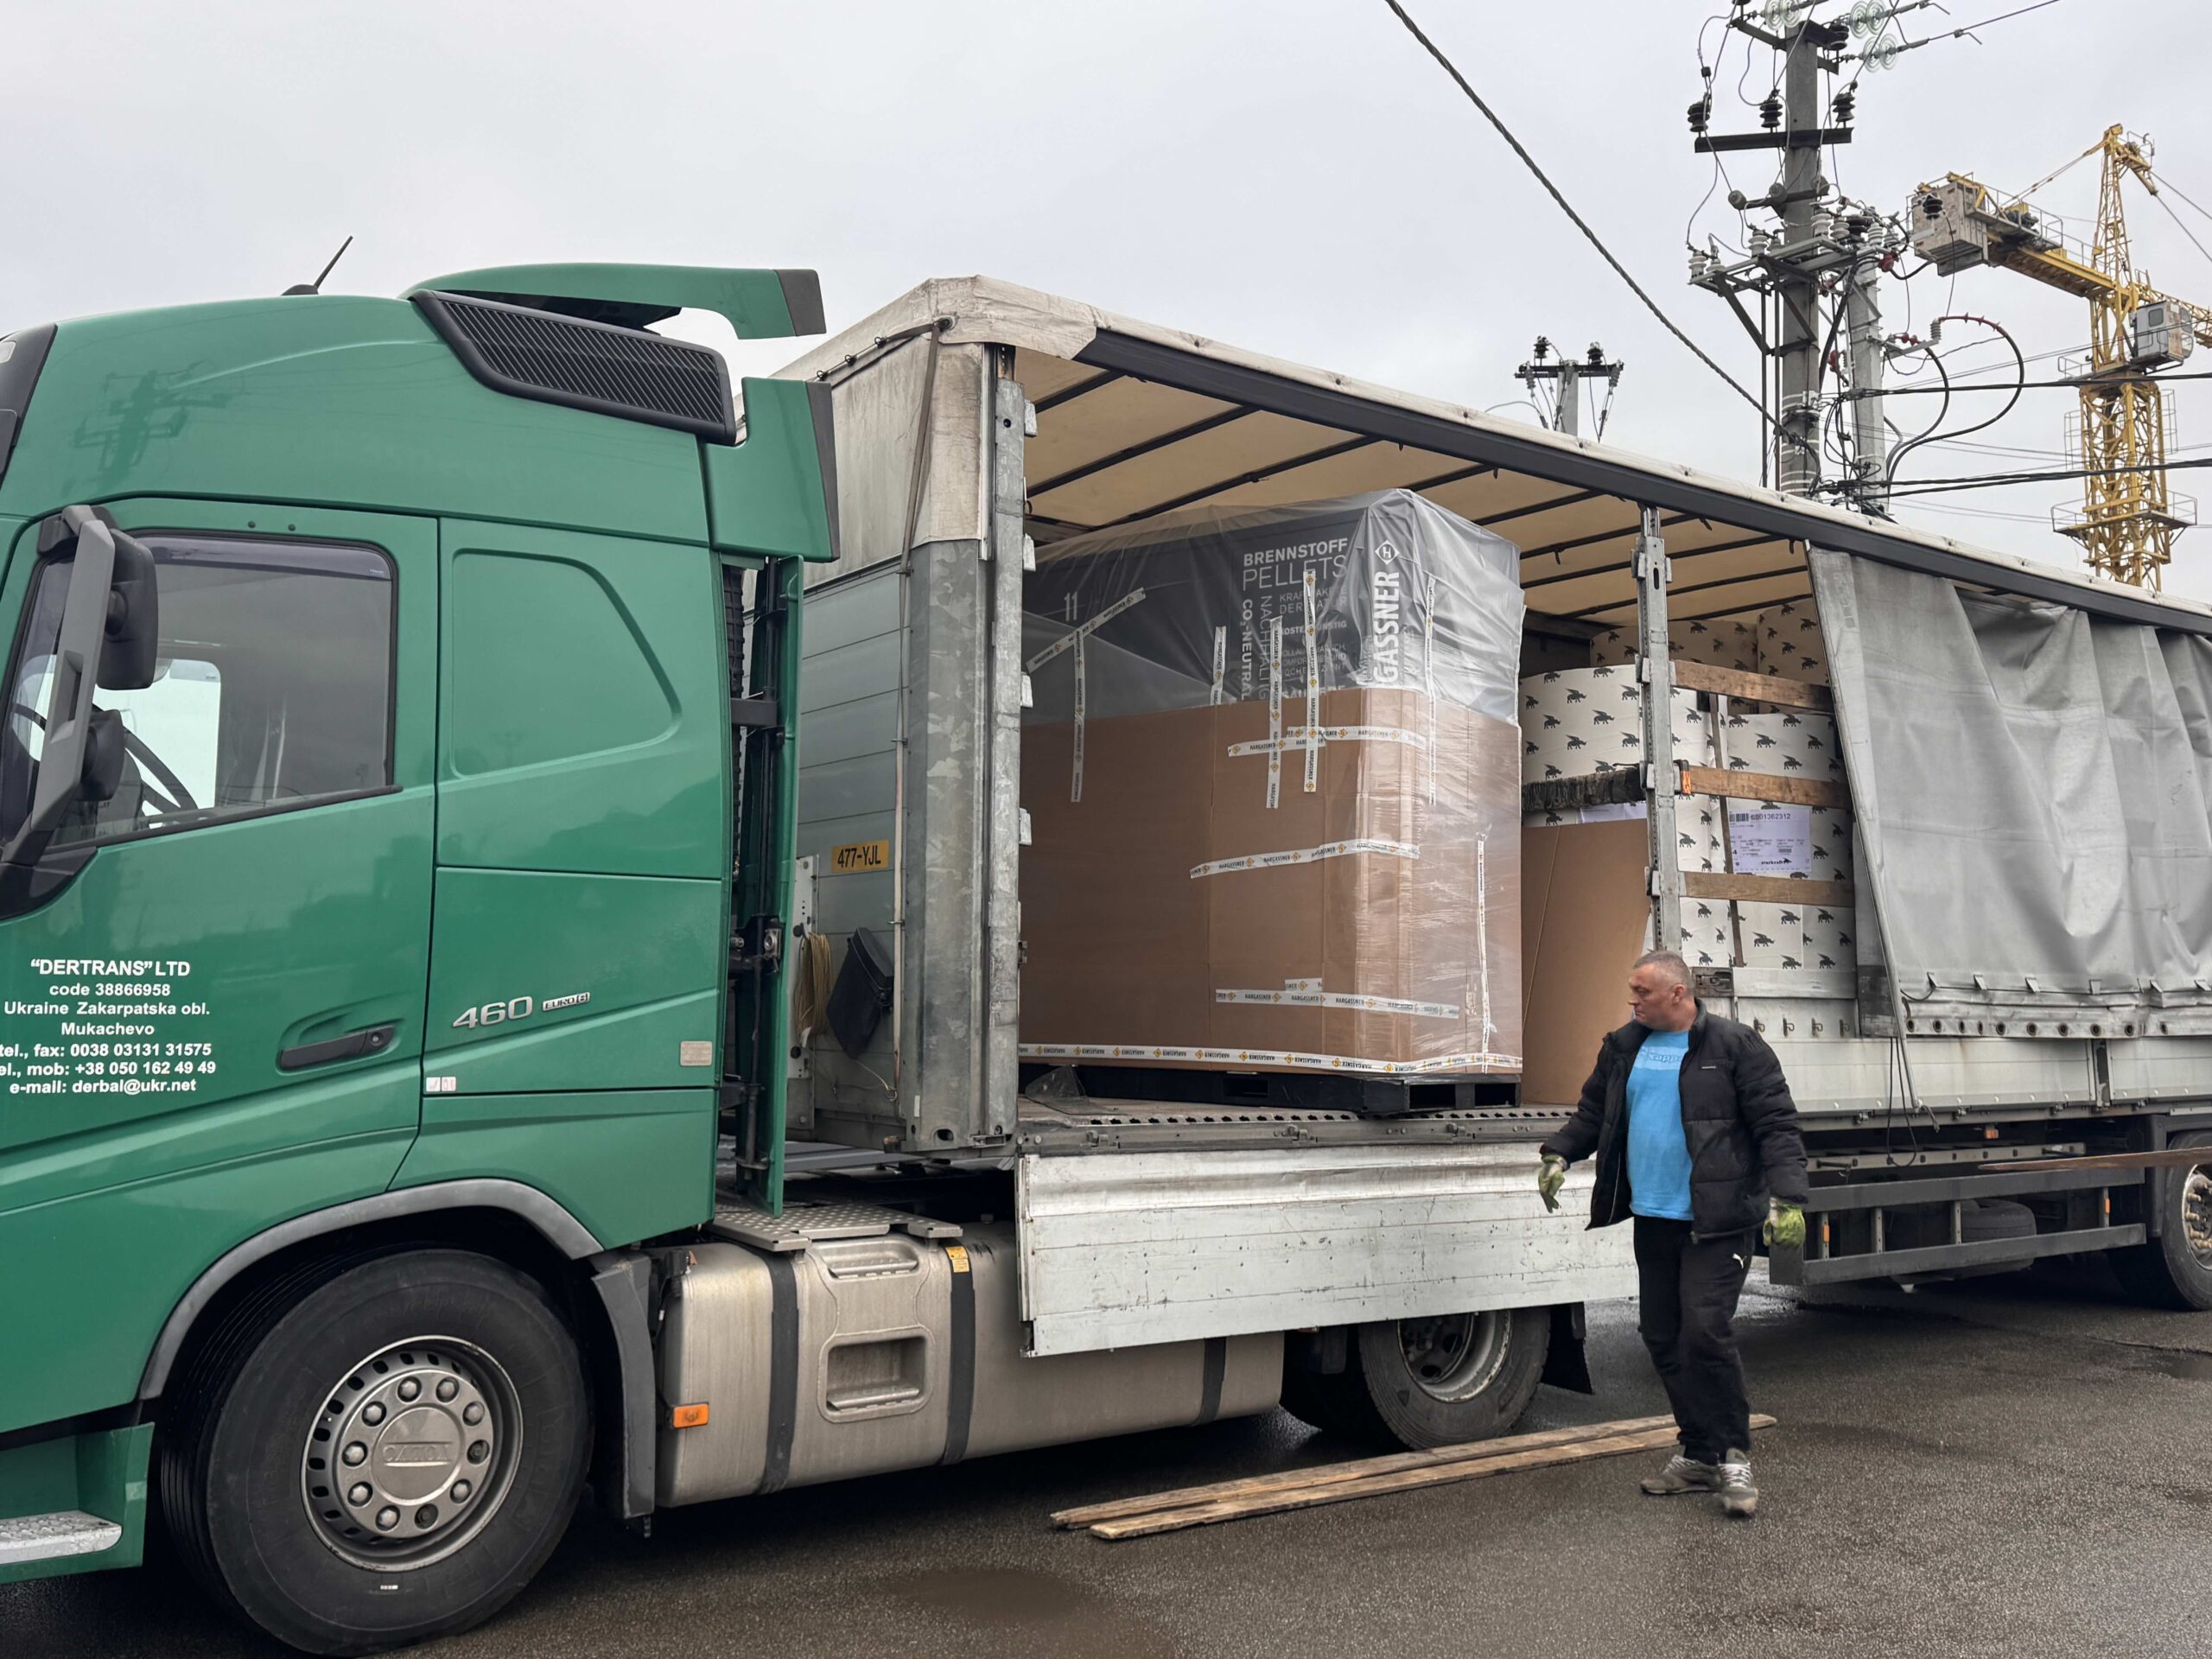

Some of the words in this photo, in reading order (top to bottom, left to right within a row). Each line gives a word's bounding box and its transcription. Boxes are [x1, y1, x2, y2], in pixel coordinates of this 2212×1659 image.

[1243, 538, 1348, 567] BRENNSTOFF
[1064, 591, 1078, 621] 11
[1280, 602, 1303, 614] DER
[1373, 571, 1401, 683] GASSNER
[837, 844, 881, 868] 477-YJL
[155, 961, 191, 976] LTD
[49, 982, 91, 996] code
[95, 982, 171, 996] 38866958
[3, 1001, 69, 1014] Ukraine
[76, 1001, 176, 1018] Zakarpatska
[181, 1002, 210, 1015] obl.
[1335, 997, 1365, 1006] HARGASSNER
[452, 995, 533, 1029] 460
[61, 1022, 155, 1036] Mukachevo
[33, 1043, 65, 1058] fax:
[70, 1043, 109, 1057] 0038
[113, 1043, 160, 1057] 03131
[165, 1043, 212, 1057] 31575
[27, 1062, 70, 1076] mob:
[74, 1061, 105, 1076] +38
[109, 1061, 138, 1075] 050
[143, 1061, 171, 1075] 162
[174, 1060, 194, 1074] 49
[197, 1060, 217, 1074] 49
[9, 1079, 67, 1094] e-mail:
[72, 1078, 197, 1096] derbal@ukr.net
